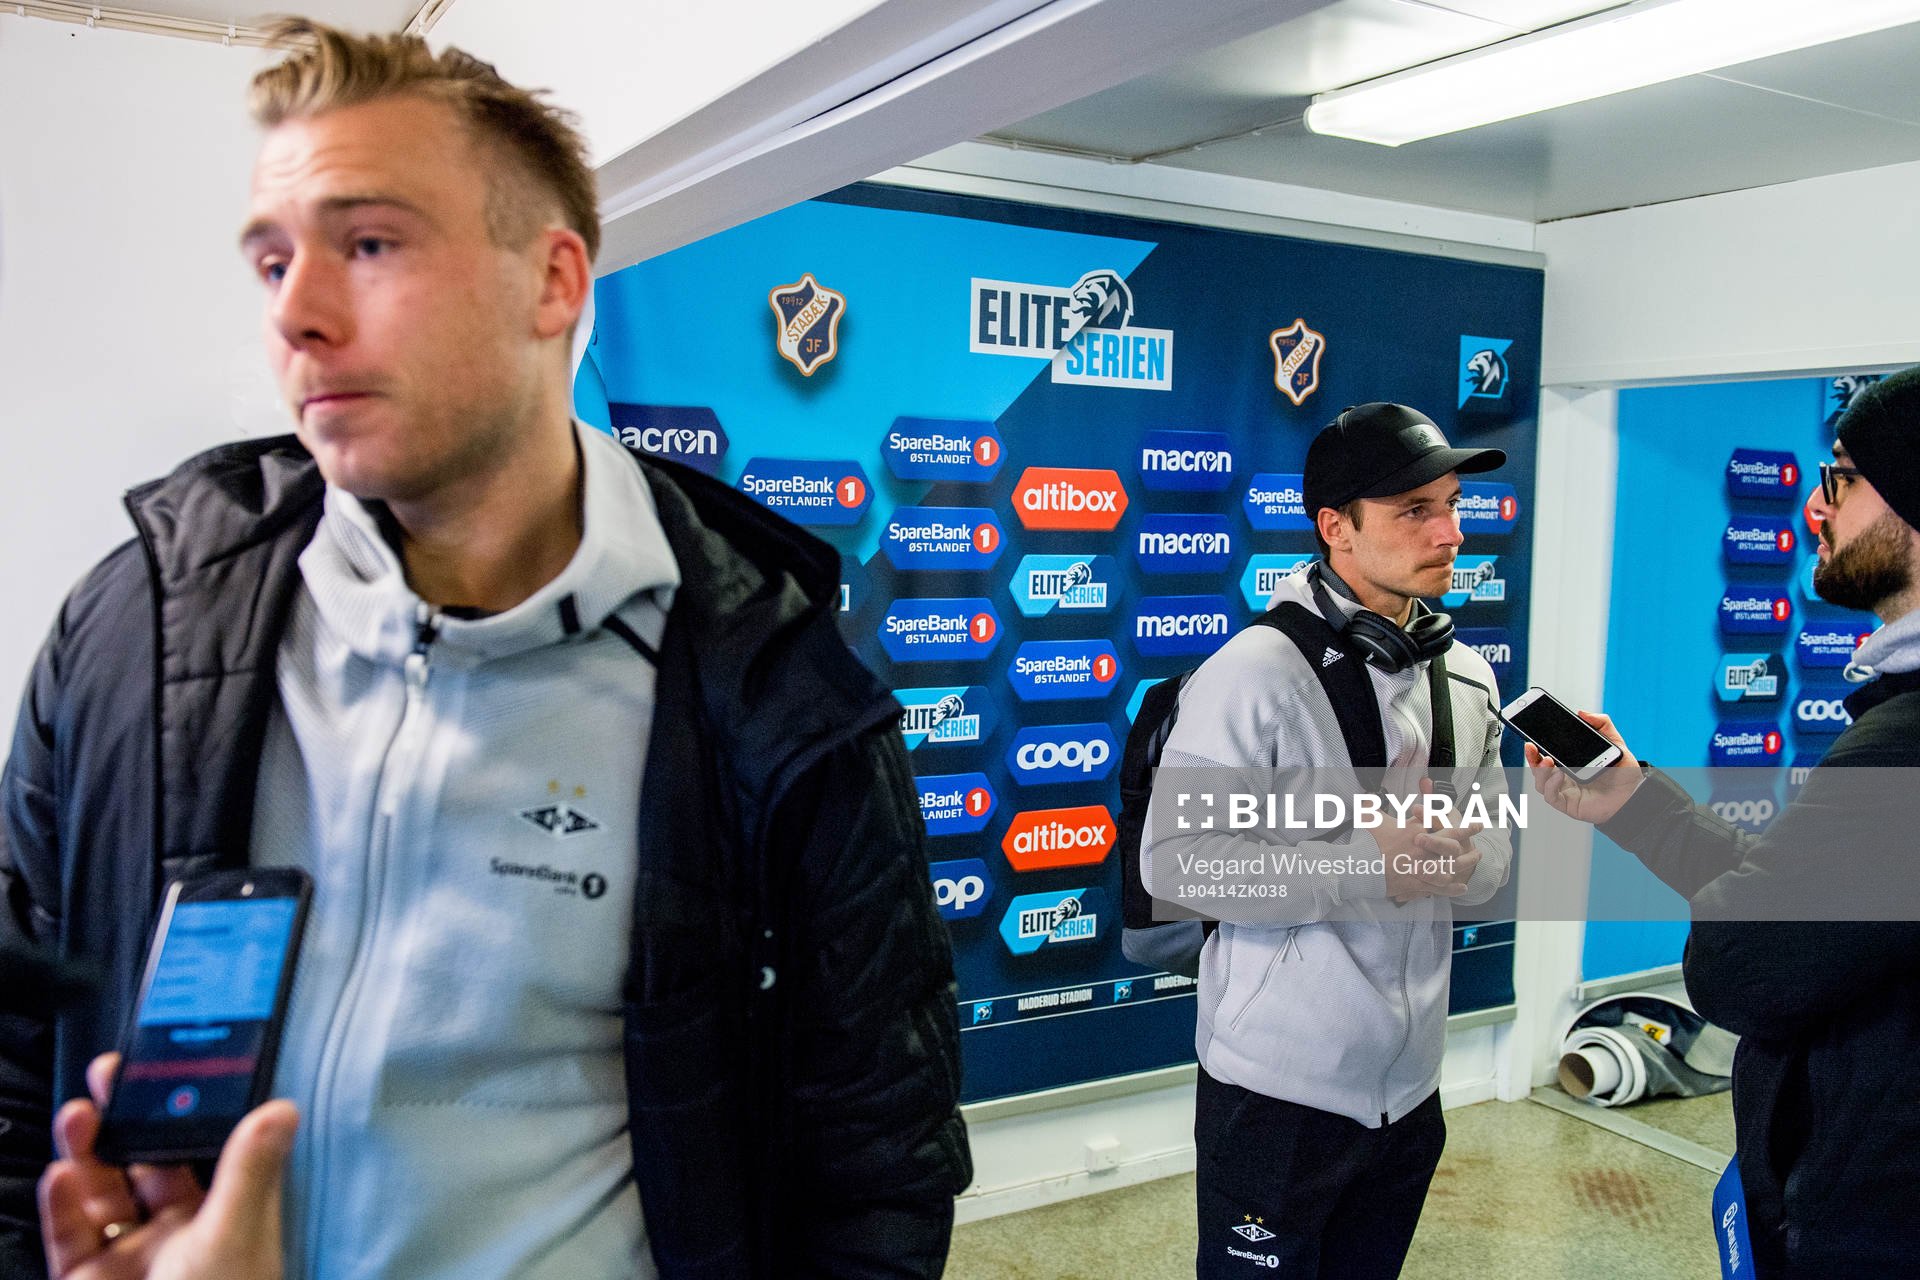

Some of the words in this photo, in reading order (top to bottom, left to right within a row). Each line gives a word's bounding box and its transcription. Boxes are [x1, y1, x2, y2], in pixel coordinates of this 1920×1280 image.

[787, 293, 828, 342] STABÆK
[978, 287, 1070, 351] ELITE
[806, 338, 822, 353] JF
[1065, 332, 1166, 381] SERIEN
[889, 433, 971, 453] SpareBank
[909, 453, 972, 465] ØSTLANDET
[1142, 448, 1232, 473] macron
[1730, 460, 1780, 476] SpareBank
[742, 474, 834, 495] SpareBank
[766, 495, 834, 507] ØSTLANDET
[1023, 481, 1117, 512] altibox
[1248, 487, 1303, 506] SpareBa
[1457, 494, 1500, 510] areBank
[1264, 505, 1307, 515] ØSTLAND
[888, 523, 971, 541] SpareBank
[1727, 527, 1776, 543] SpareBank
[908, 542, 971, 553] ØSTLANDET
[1139, 531, 1230, 554] macron
[1032, 573, 1067, 596] ELITE
[1063, 585, 1104, 605] SERIEN
[1722, 597, 1773, 612] SpareBank
[886, 614, 968, 634] SpareBank
[1136, 613, 1228, 638] macron
[904, 633, 968, 645] ØSTLANDET
[1800, 632, 1856, 646] SpareBank
[1015, 655, 1091, 675] SpareBank
[1034, 673, 1091, 684] ØSTLANDET
[900, 707, 937, 731] ELITE
[1797, 699, 1853, 725] coo
[934, 718, 977, 739] SERIEN
[1016, 739, 1110, 773] coop
[918, 790, 964, 808] eBank
[921, 808, 964, 820] LANDET
[1013, 822, 1107, 854] altibox
[1022, 911, 1060, 935] ELITE
[1054, 918, 1094, 940] SERIEN
[1018, 993, 1059, 1011] NADDERUD
[1059, 988, 1093, 1004] STADION
